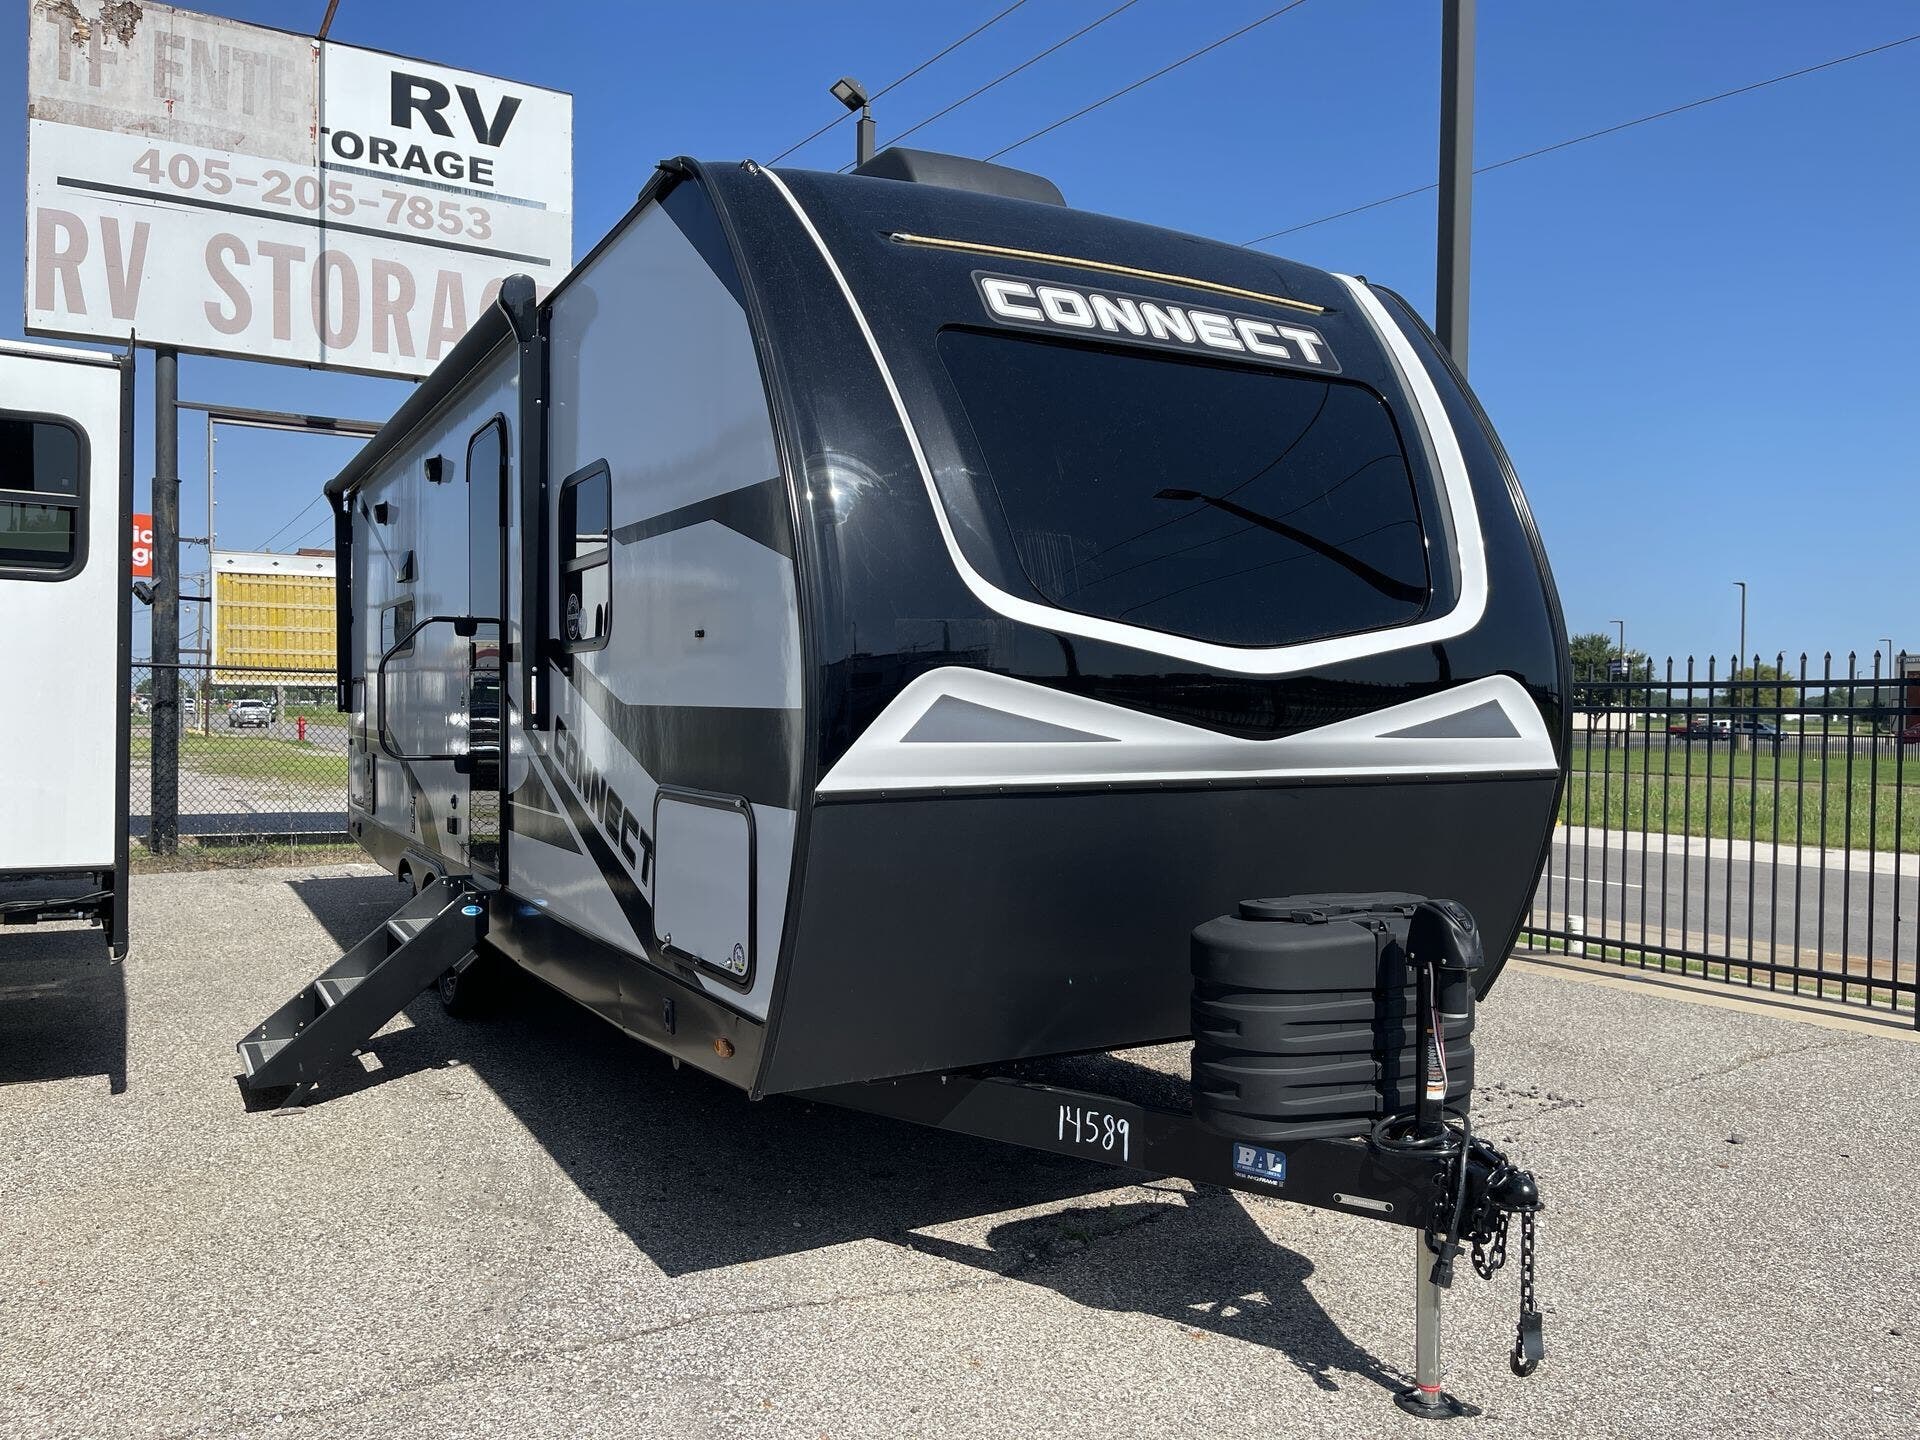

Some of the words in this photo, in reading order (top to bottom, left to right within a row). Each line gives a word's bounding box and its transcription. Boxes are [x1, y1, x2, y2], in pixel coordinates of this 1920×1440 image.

[390, 70, 523, 148] RV
[132, 148, 492, 240] 405-205-7853
[35, 207, 150, 321] RV
[981, 277, 1322, 364] CONNECT
[554, 714, 653, 888] CONNECT
[1058, 1105, 1130, 1162] 14589
